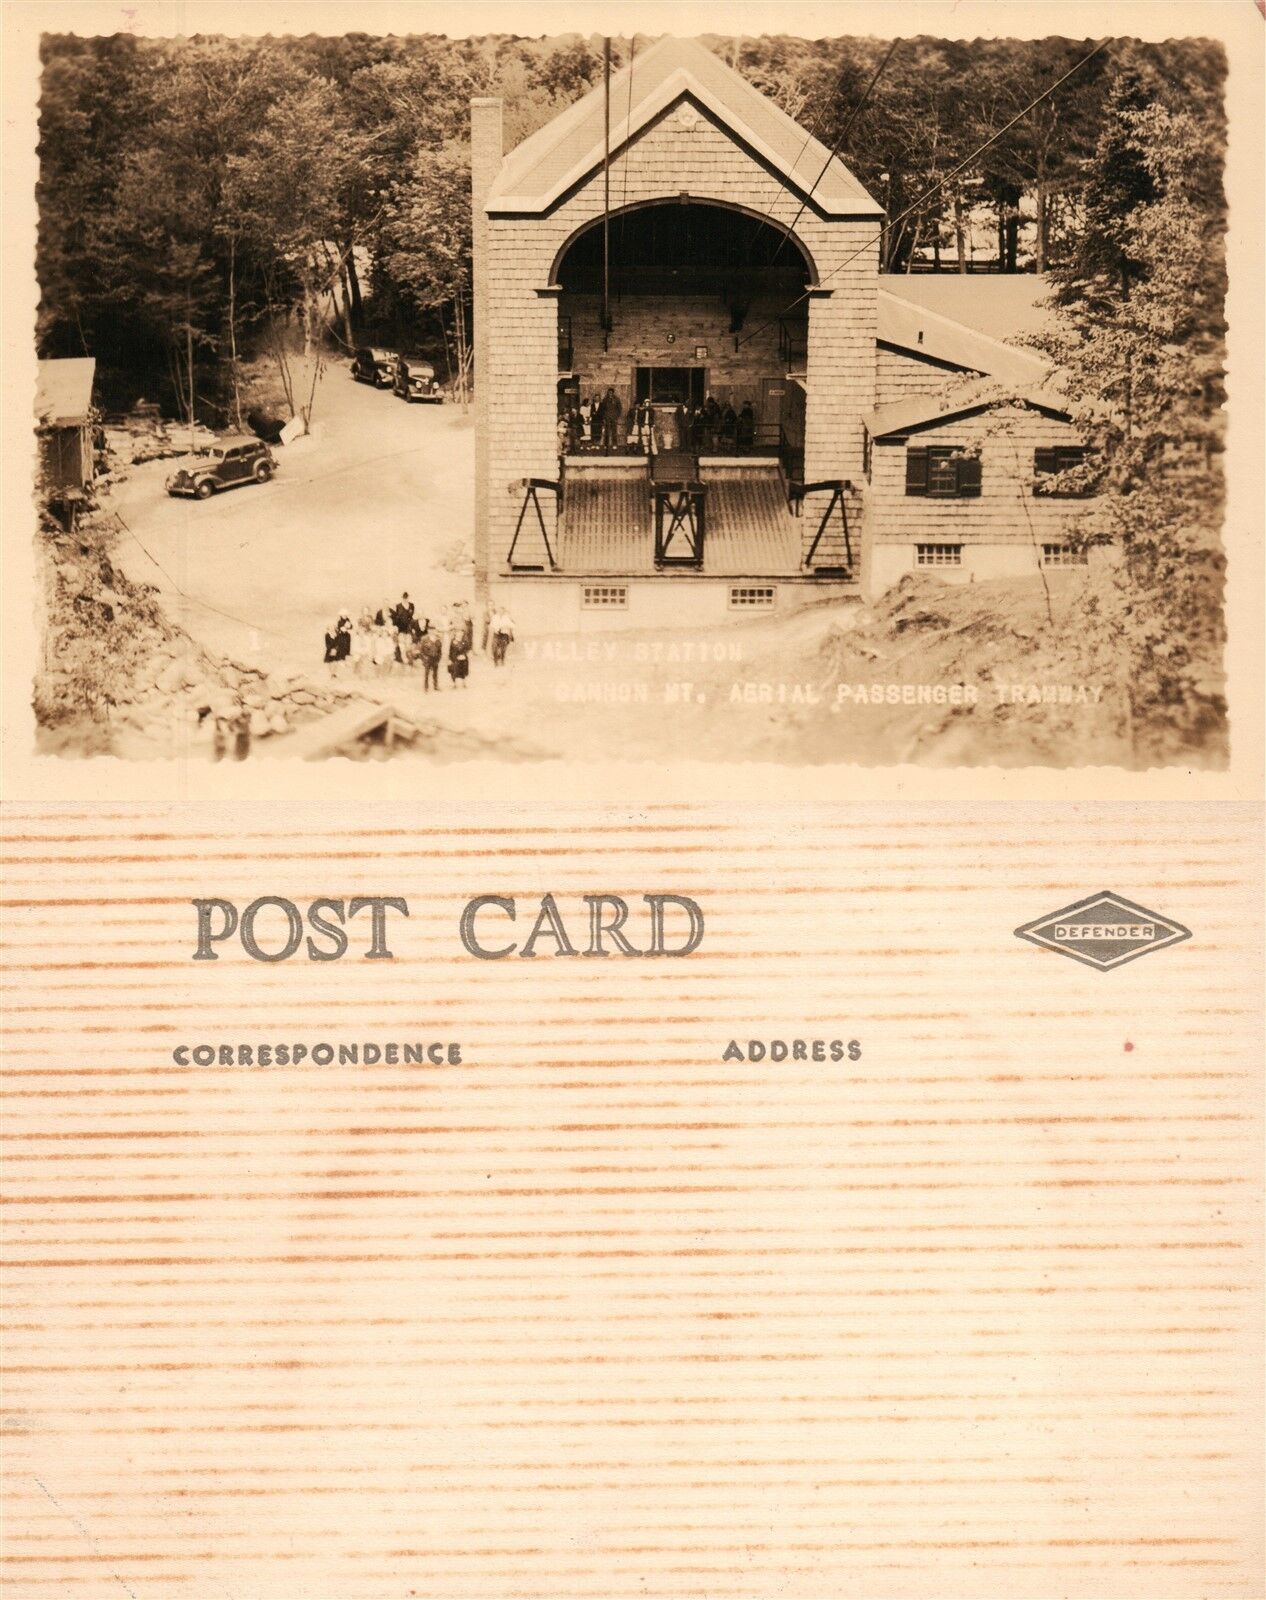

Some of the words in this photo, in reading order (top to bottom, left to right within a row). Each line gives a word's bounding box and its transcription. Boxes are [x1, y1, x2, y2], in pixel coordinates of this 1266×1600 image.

[192, 896, 410, 962] POST
[459, 892, 706, 960] CARD
[1056, 926, 1153, 938] DEFENDER
[172, 1042, 463, 1066] CORRESPONDENCE
[722, 1039, 863, 1063] ADDRESS
